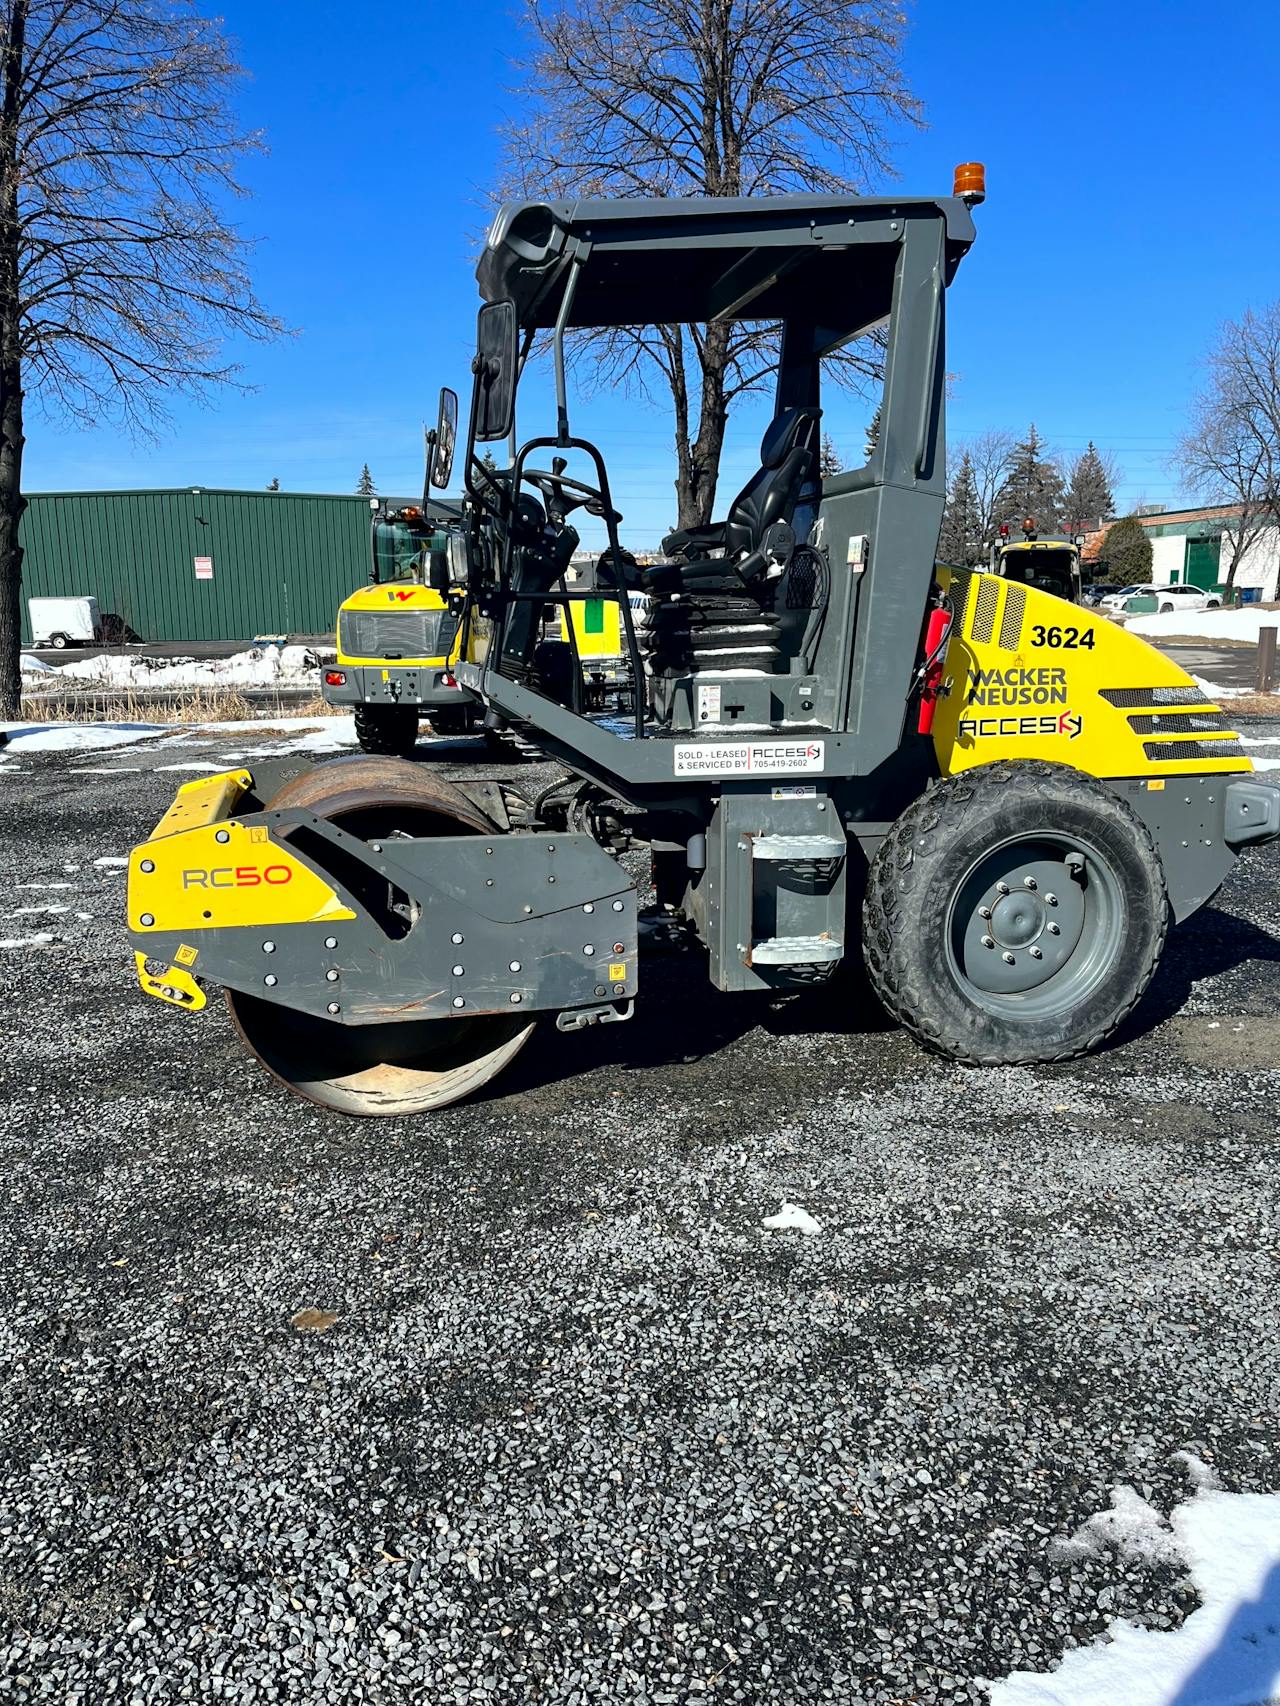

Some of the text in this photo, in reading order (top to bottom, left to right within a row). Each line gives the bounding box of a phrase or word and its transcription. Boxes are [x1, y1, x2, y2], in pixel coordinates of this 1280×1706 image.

[1031, 625, 1095, 650] 3624
[967, 668, 1067, 686] WACKER
[968, 687, 1067, 706] NEUSON
[678, 751, 702, 759] SOLD
[711, 750, 747, 758] LEASED
[754, 759, 808, 768] 705-419-2602
[686, 760, 732, 769] SERVICED
[735, 760, 747, 768] BY
[183, 865, 292, 889] RC50
